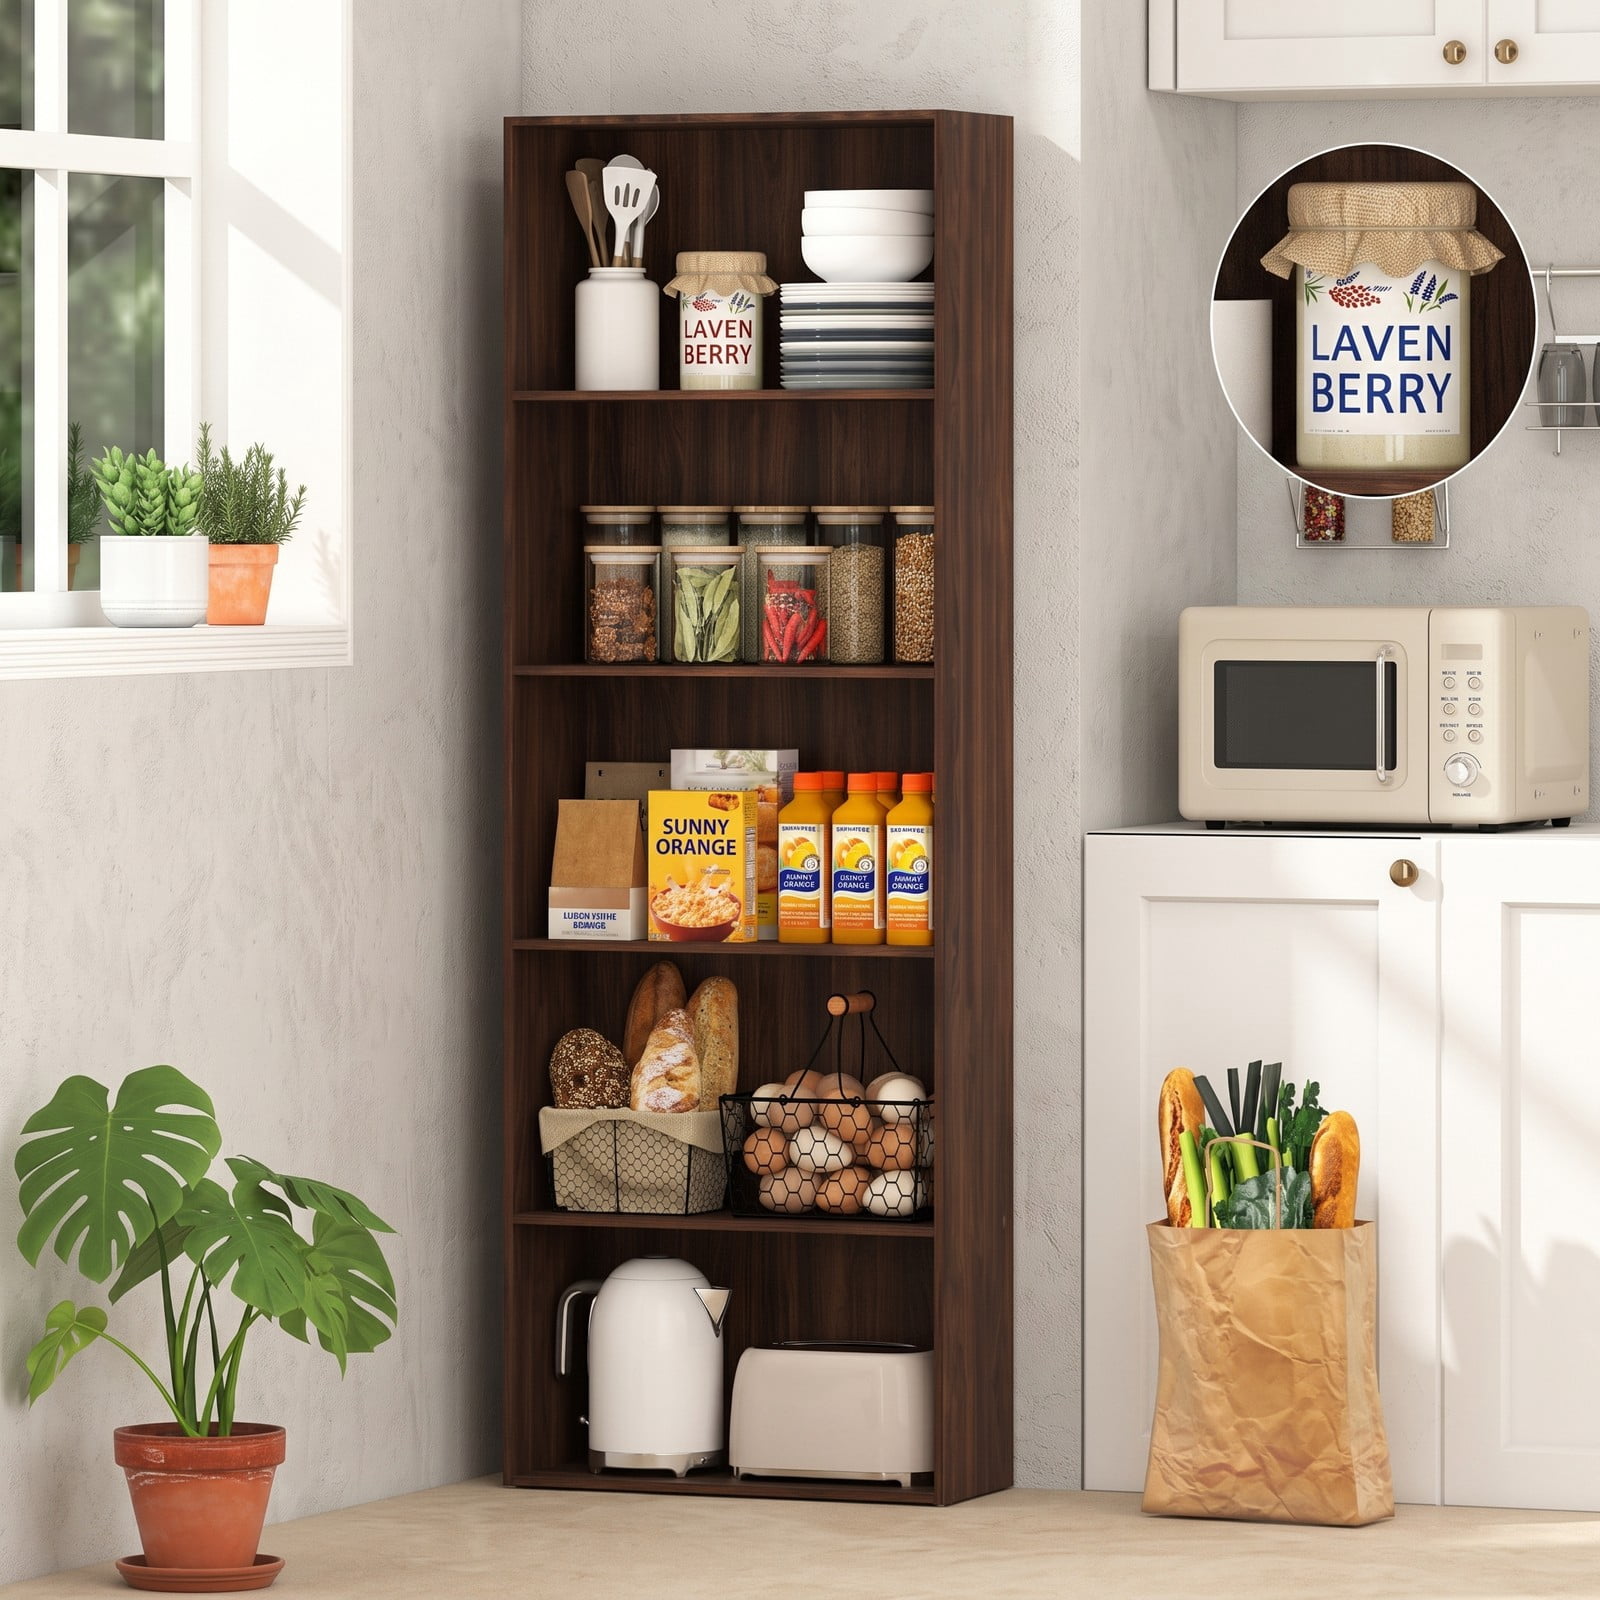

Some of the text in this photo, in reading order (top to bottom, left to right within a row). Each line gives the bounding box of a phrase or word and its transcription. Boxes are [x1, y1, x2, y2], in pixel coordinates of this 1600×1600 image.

[684, 319, 752, 339] LAVEN
[1312, 324, 1452, 362] LAVEN
[684, 344, 752, 365] BERRY
[1312, 372, 1452, 414] BERRY
[662, 818, 730, 836] SUNNY
[656, 838, 737, 856] ORANGE
